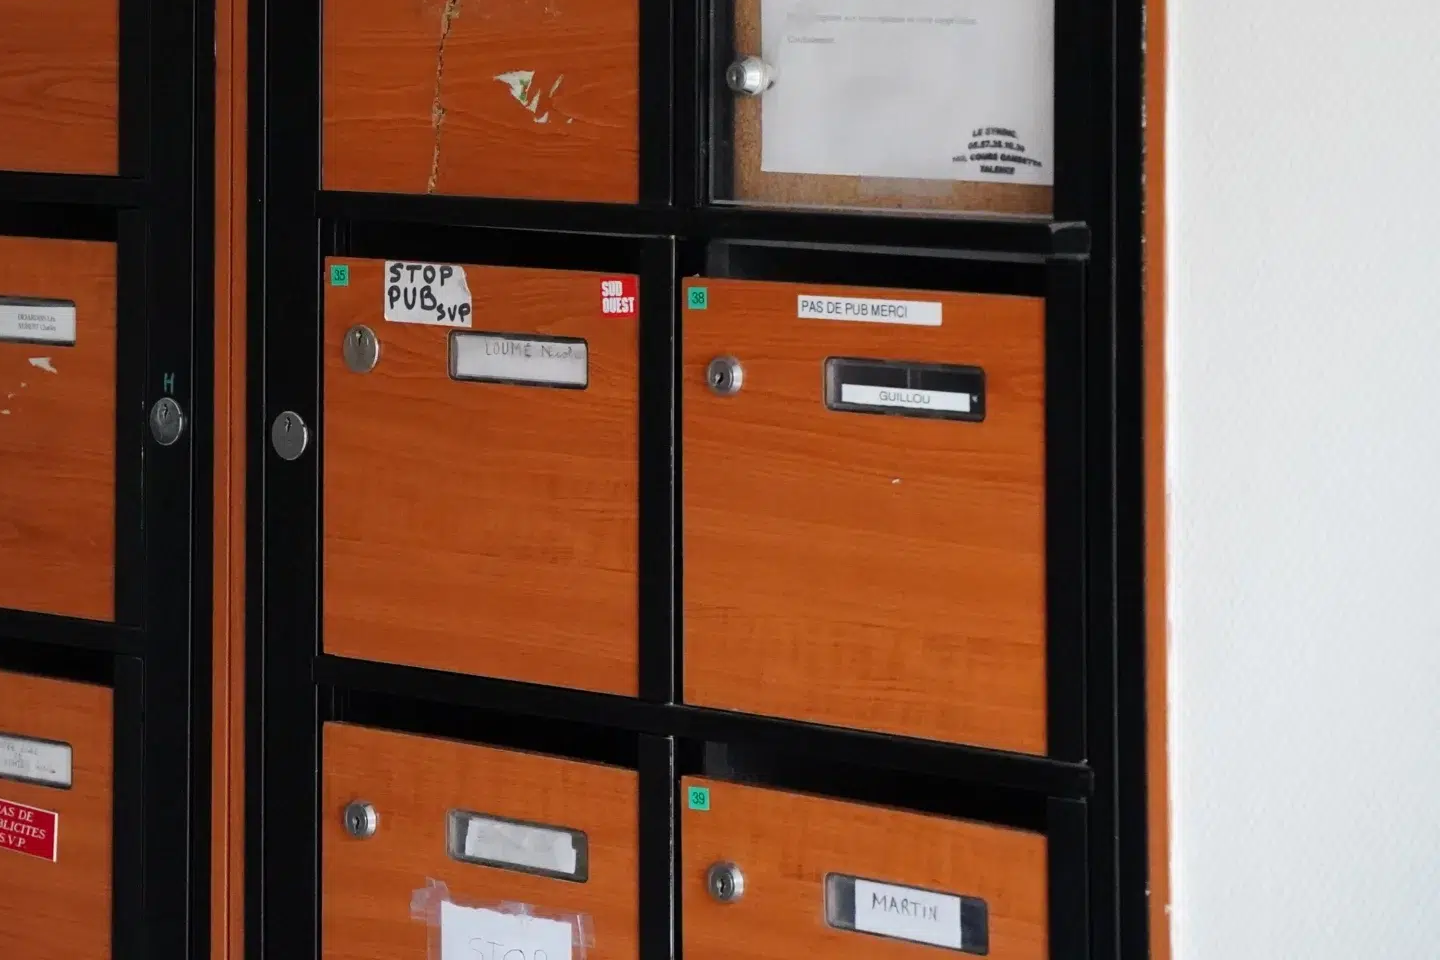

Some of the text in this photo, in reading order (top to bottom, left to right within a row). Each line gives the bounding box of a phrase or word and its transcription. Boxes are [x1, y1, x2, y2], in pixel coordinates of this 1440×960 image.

[334, 269, 345, 282] 35
[389, 263, 453, 286] STOP
[601, 280, 623, 297] SUD
[388, 285, 470, 323] PUB SVP
[602, 296, 635, 315] OUEST
[691, 292, 705, 305] 38
[801, 301, 908, 319] PAS DE PUB MERCI
[879, 390, 930, 405] GUILLOU
[692, 792, 706, 805] 39
[19, 809, 33, 823] DE
[872, 892, 938, 921] MARTIN
